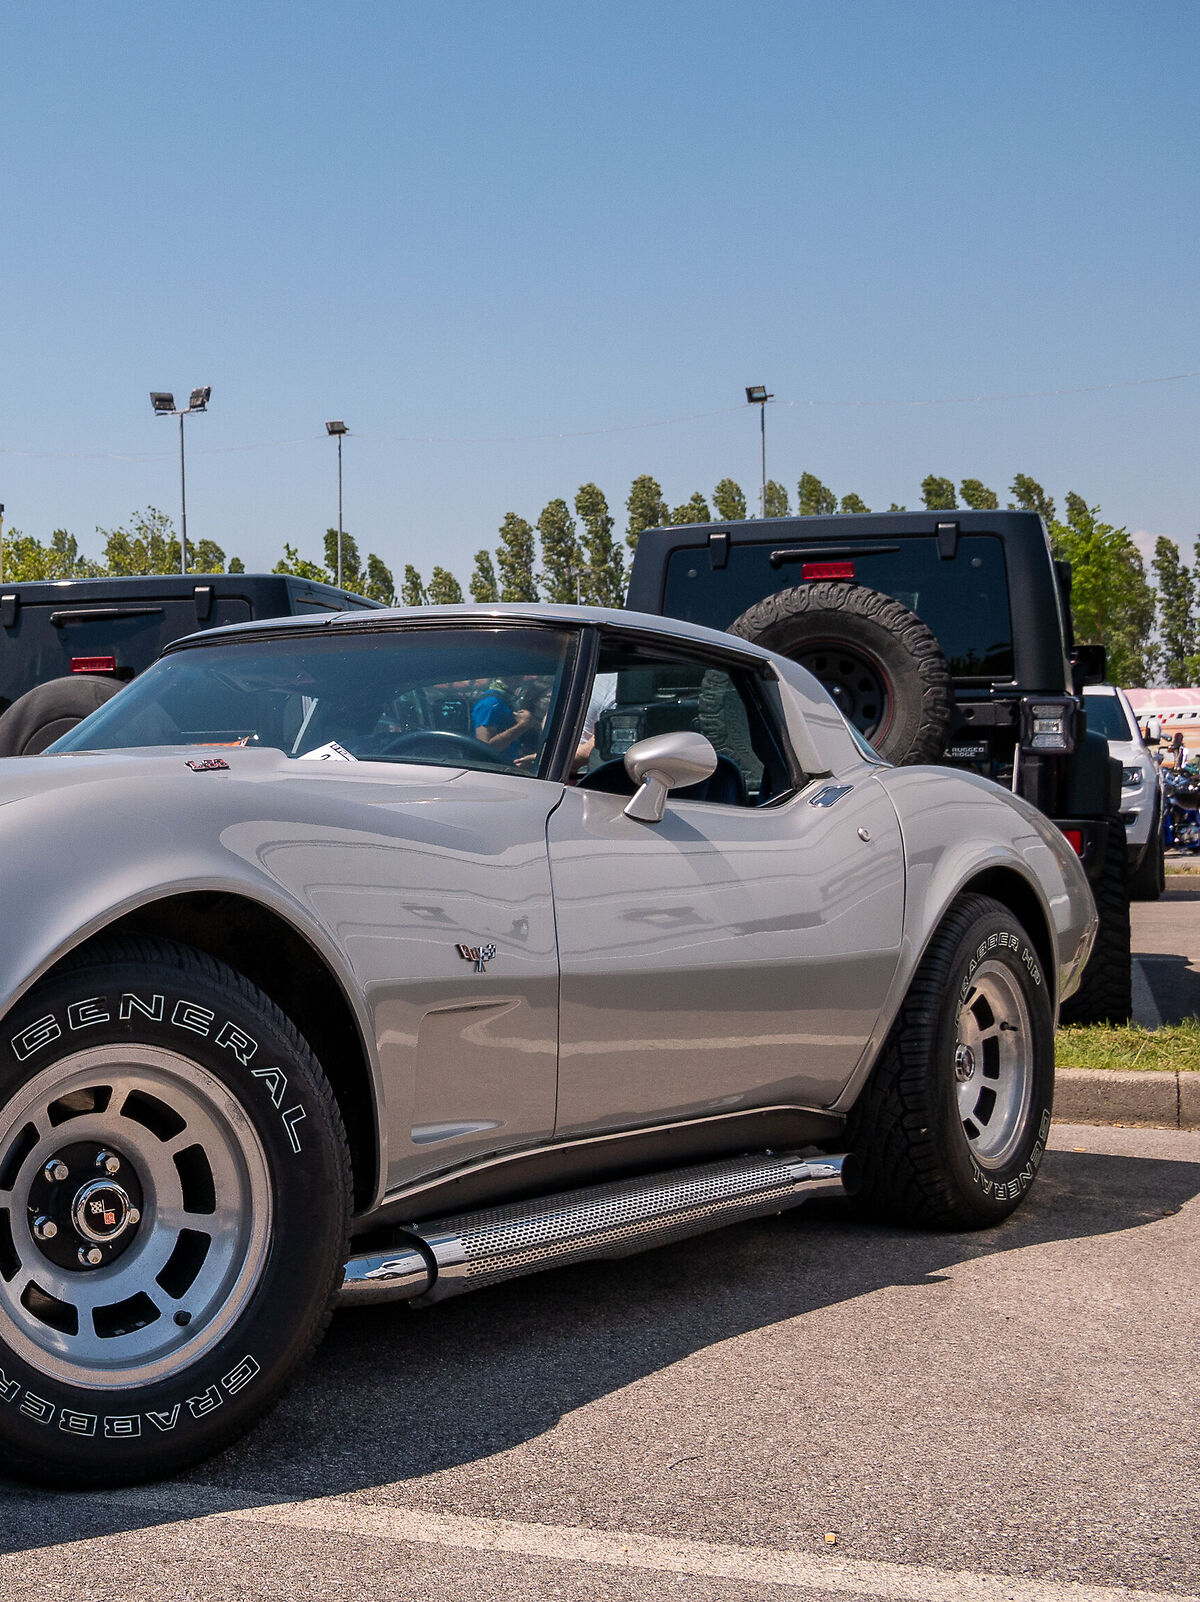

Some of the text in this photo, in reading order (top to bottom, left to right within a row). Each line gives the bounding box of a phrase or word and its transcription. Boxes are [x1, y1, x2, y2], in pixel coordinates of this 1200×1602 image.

[1021, 948, 1041, 985] HP
[12, 993, 307, 1154] GENERAL
[969, 1109, 1050, 1200] GENERAL
